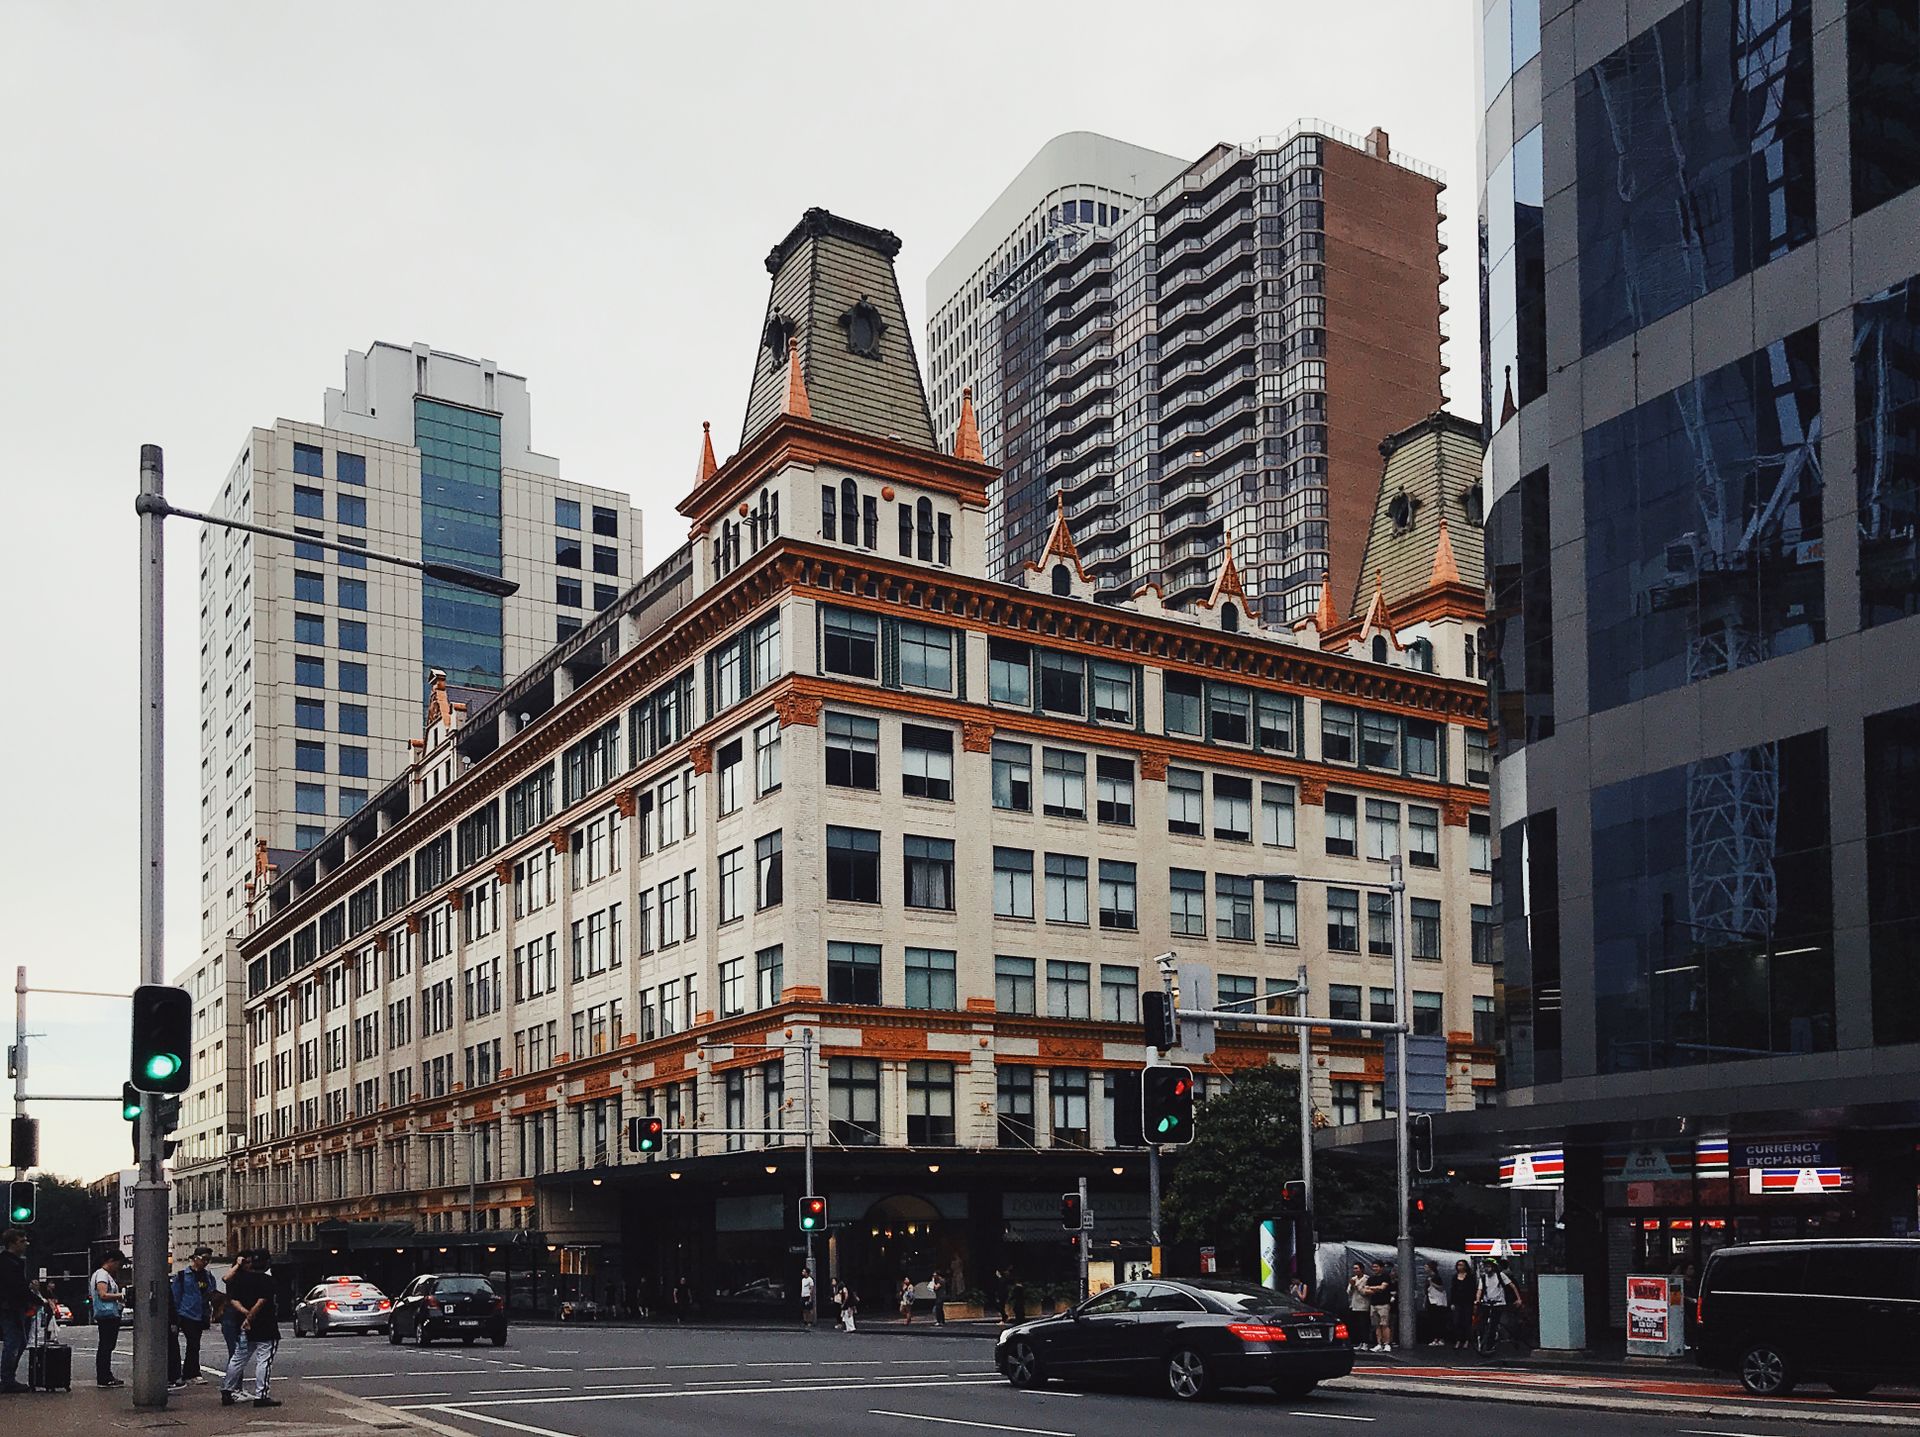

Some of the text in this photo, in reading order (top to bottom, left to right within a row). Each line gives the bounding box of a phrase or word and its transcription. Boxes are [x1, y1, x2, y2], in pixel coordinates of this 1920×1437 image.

[1745, 1142, 1821, 1154] CURRENCY
[1635, 1156, 1657, 1167] CITY
[1746, 1154, 1822, 1166] EXCHANGE
[124, 1186, 134, 1197] YO
